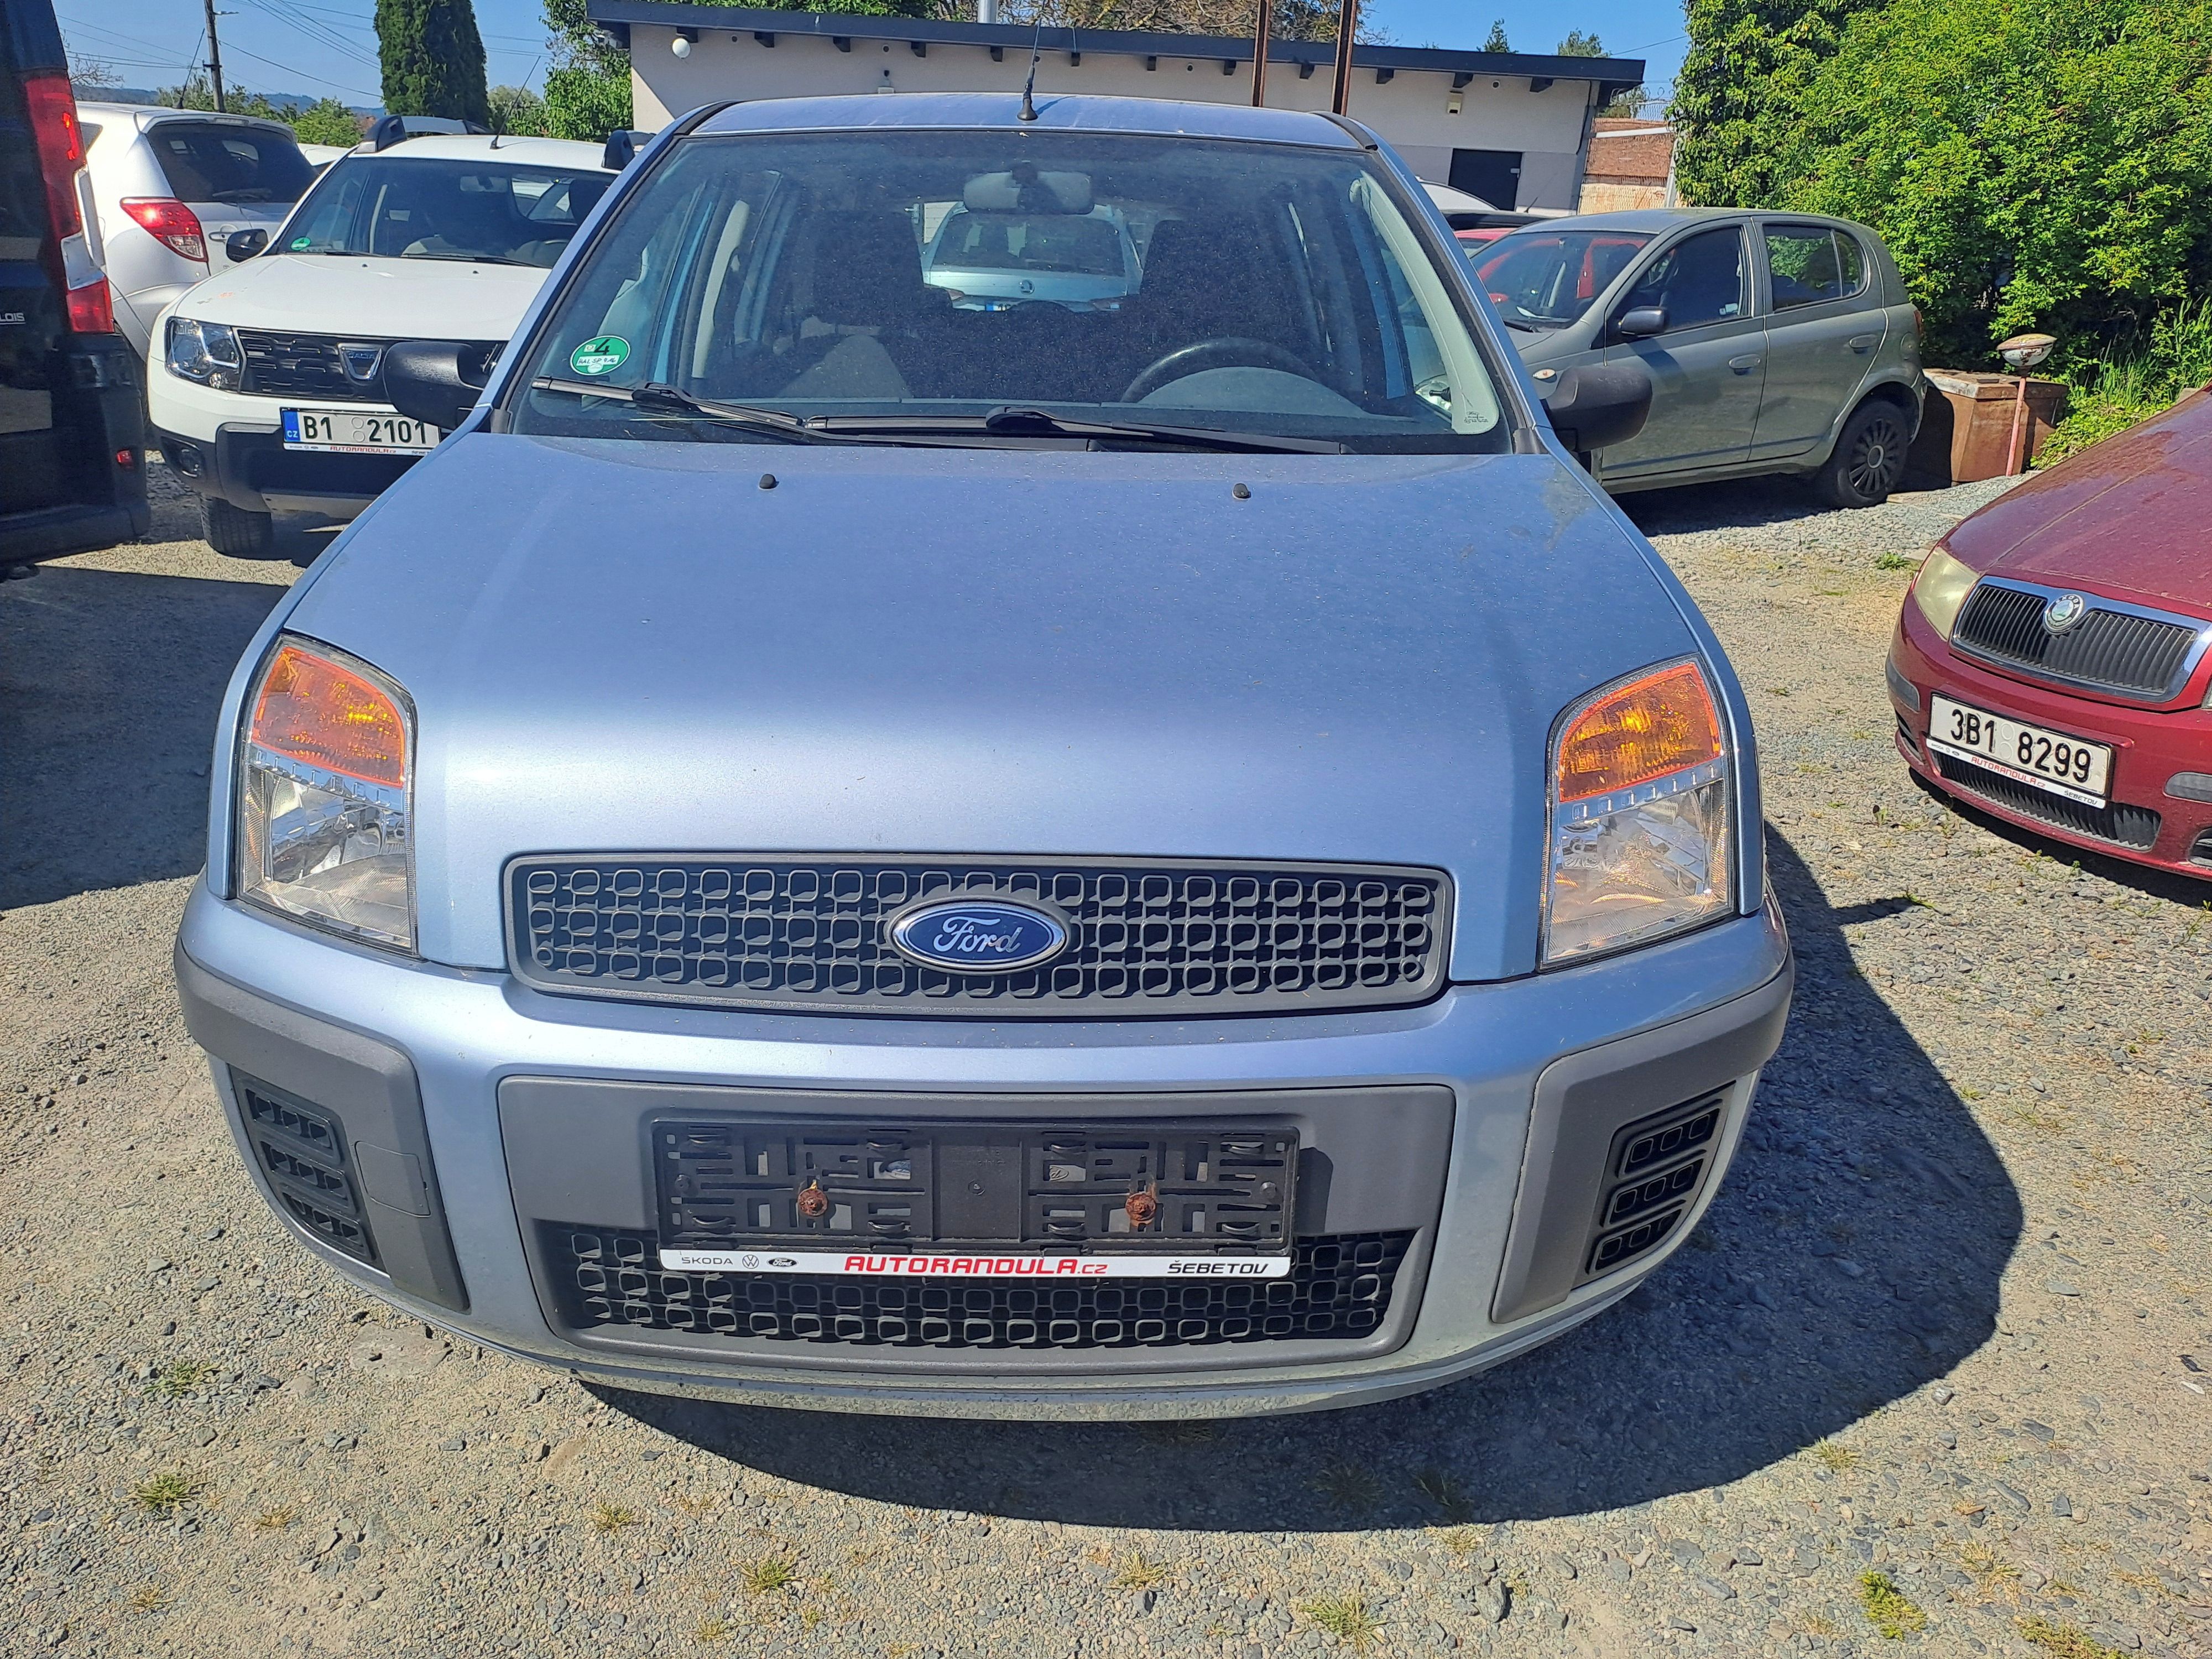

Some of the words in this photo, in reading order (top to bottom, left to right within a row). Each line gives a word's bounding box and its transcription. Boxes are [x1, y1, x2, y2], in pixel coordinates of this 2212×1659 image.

[594, 338, 611, 354] 4
[303, 415, 332, 441] B1
[367, 419, 426, 444] 2101
[1950, 708, 1995, 753] 3B1
[2017, 731, 2091, 783] 8299
[933, 915, 1024, 953] Ford
[1167, 1259, 1269, 1275] ŠEBETOV
